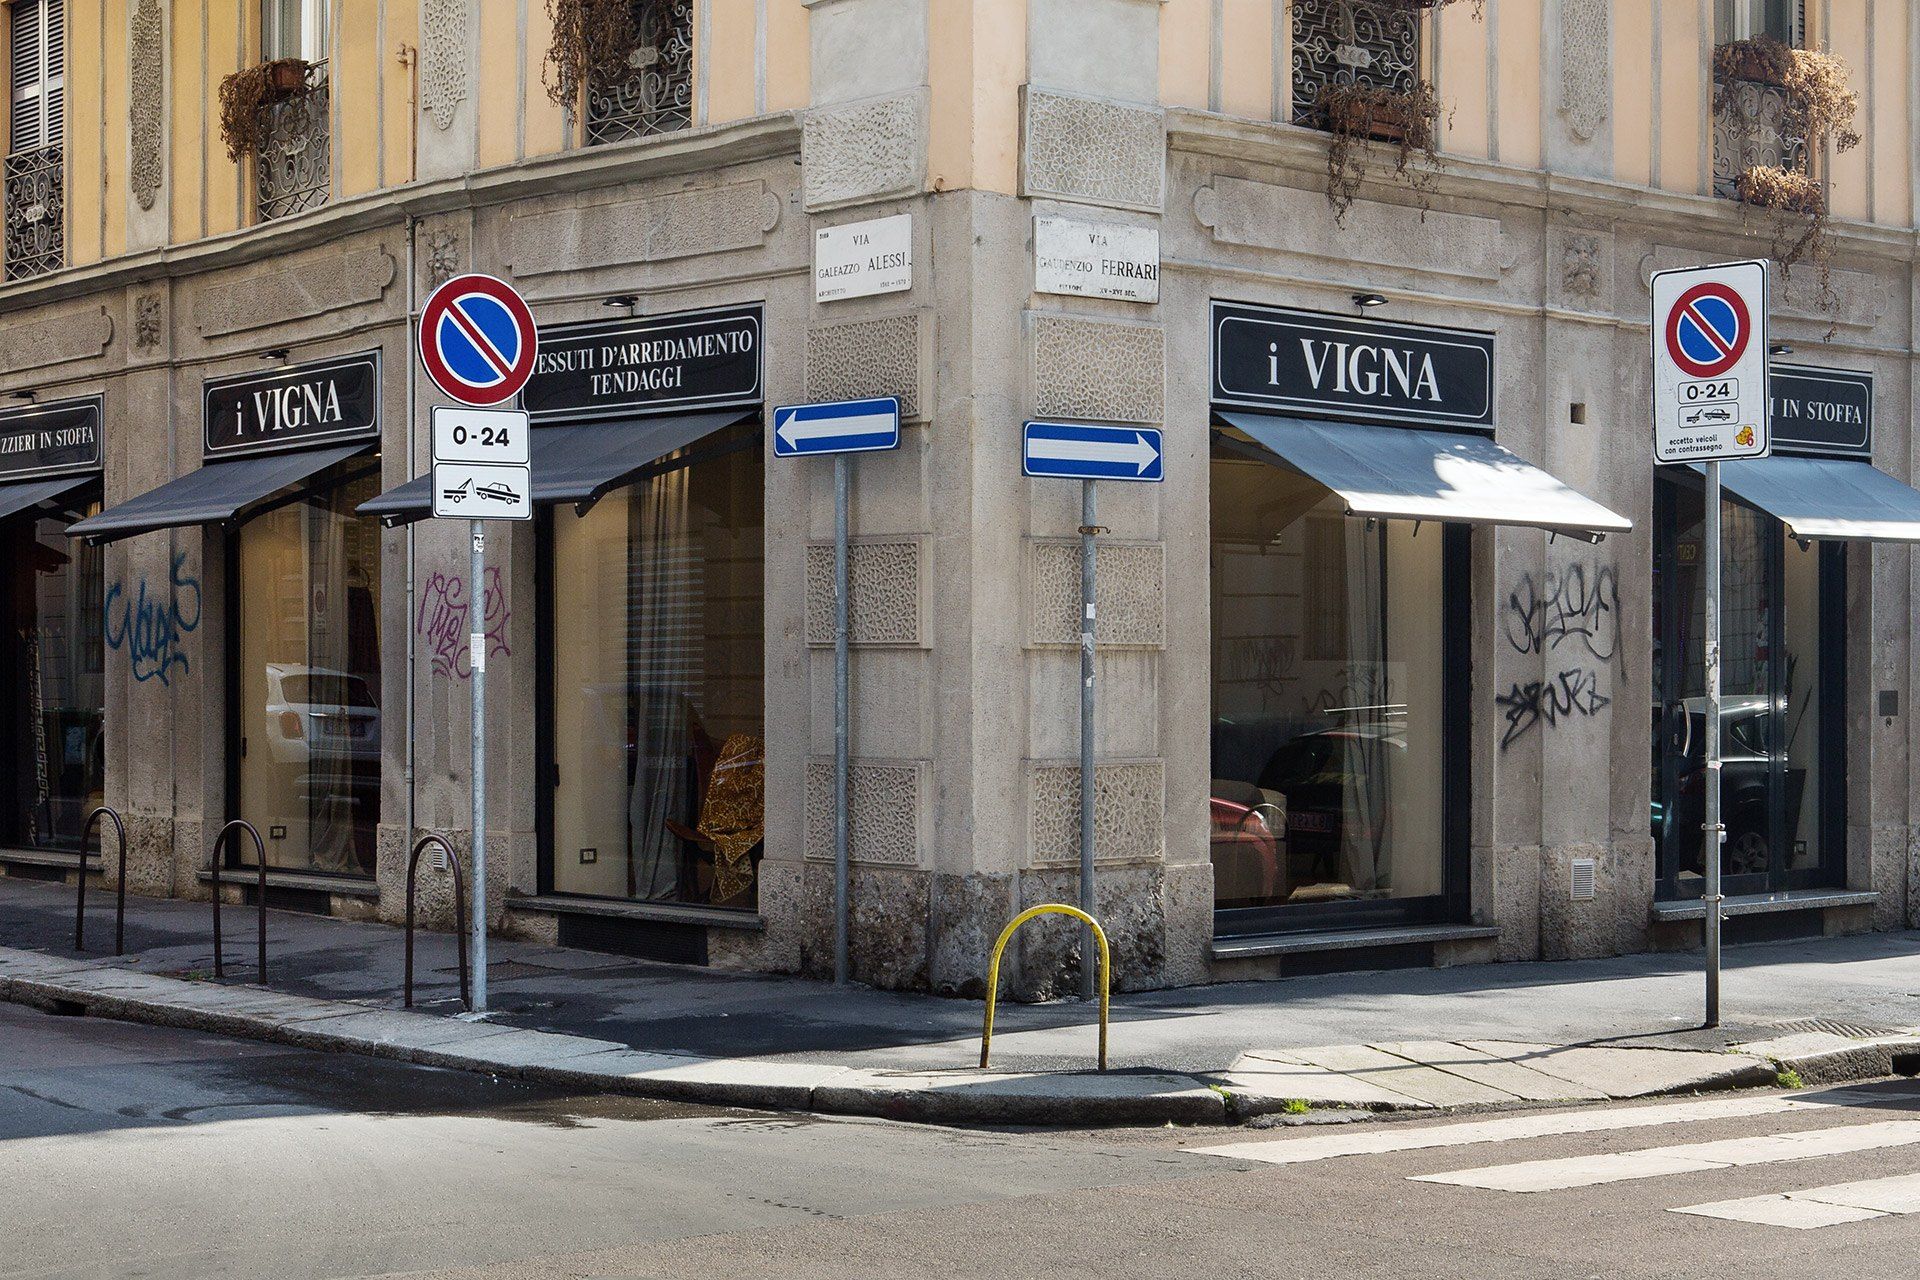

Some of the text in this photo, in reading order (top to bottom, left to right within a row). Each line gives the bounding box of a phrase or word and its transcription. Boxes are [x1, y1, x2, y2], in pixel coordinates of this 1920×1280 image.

[853, 234, 870, 246] VIA
[1088, 234, 1108, 247] VIA
[818, 251, 906, 279] GALEAZZO ALESSI
[1101, 259, 1157, 281] FERRARI
[530, 348, 595, 376] ESSUTI
[1267, 338, 1443, 402] i VIGNA
[590, 365, 683, 397] TENDAGGI
[235, 379, 343, 436] i VIGNA
[1782, 398, 1800, 418] IN
[1806, 400, 1862, 424] STOFFA
[40, 431, 52, 449] IN
[56, 426, 95, 447] STOFFA
[1664, 443, 1723, 455] con contrassegno
[1669, 433, 1718, 446] eccetto veicoli
